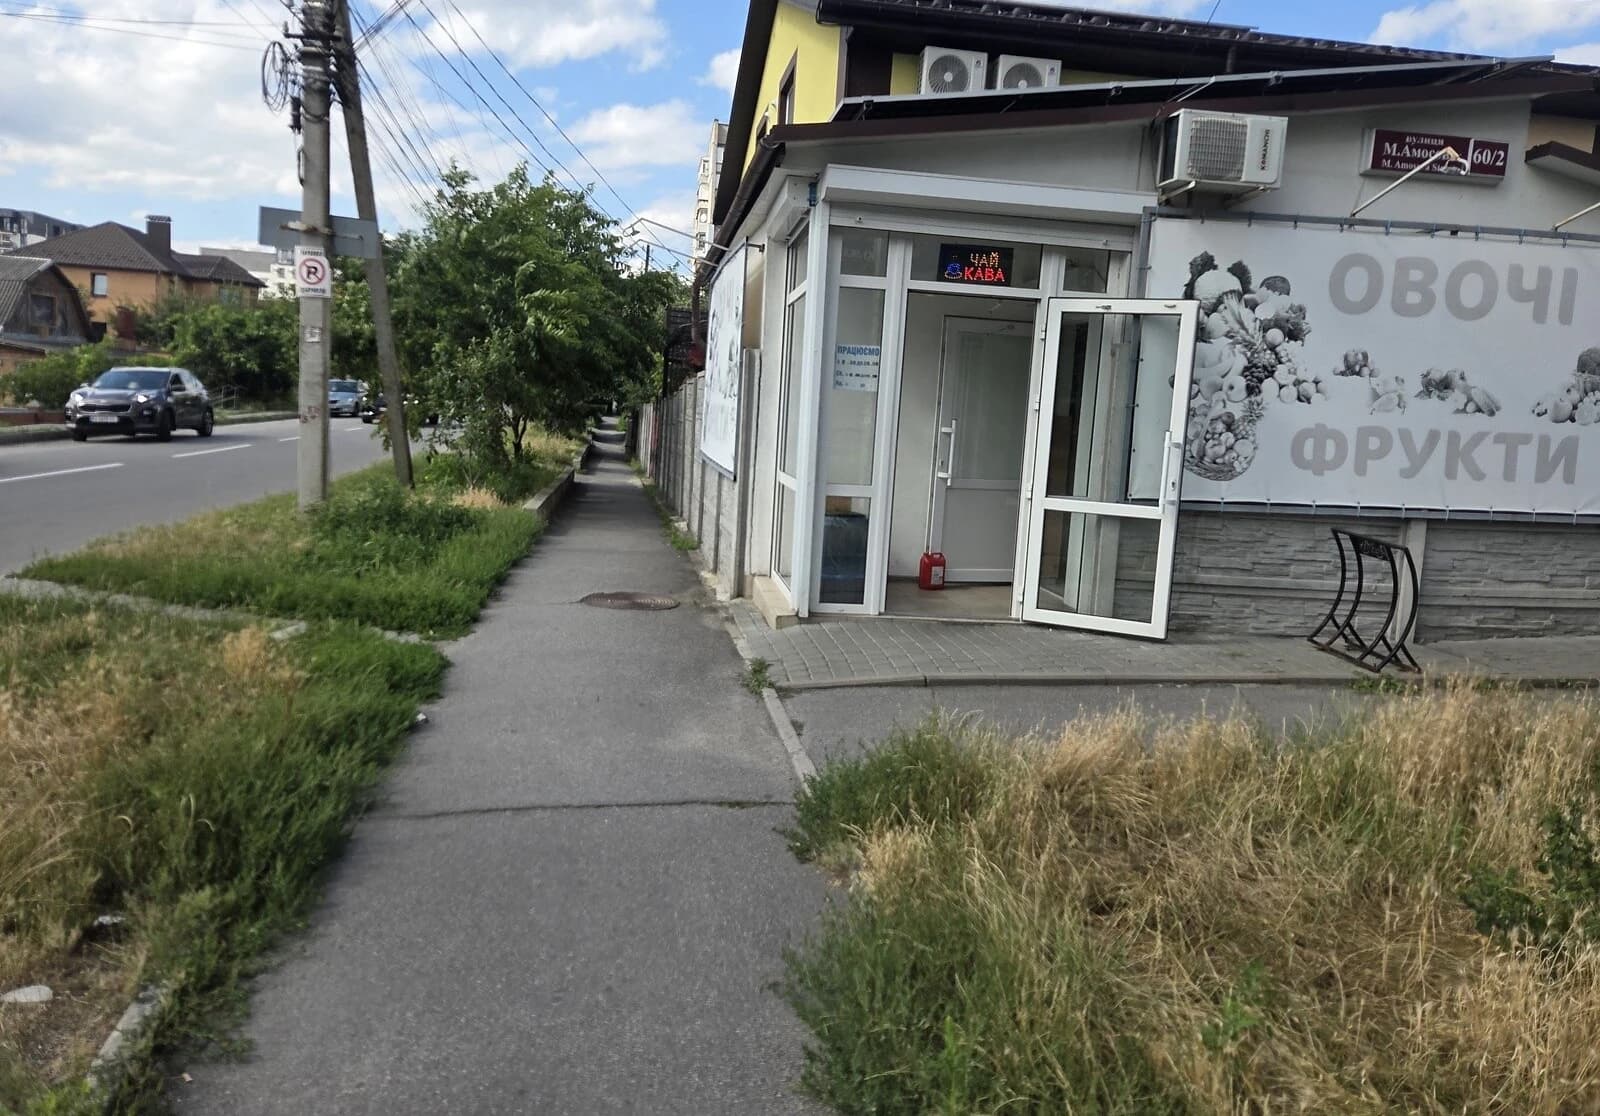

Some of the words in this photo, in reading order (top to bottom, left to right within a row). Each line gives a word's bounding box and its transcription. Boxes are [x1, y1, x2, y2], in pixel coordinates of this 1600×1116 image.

[1473, 148, 1505, 166] 60/2
[970, 252, 999, 267] ЧАЙ
[964, 267, 1005, 282] КАВА
[1328, 252, 1579, 326] ОВОЧІ
[837, 345, 880, 356] ПРАЦЮЄМО
[1290, 422, 1580, 485] ФРУКТИ
